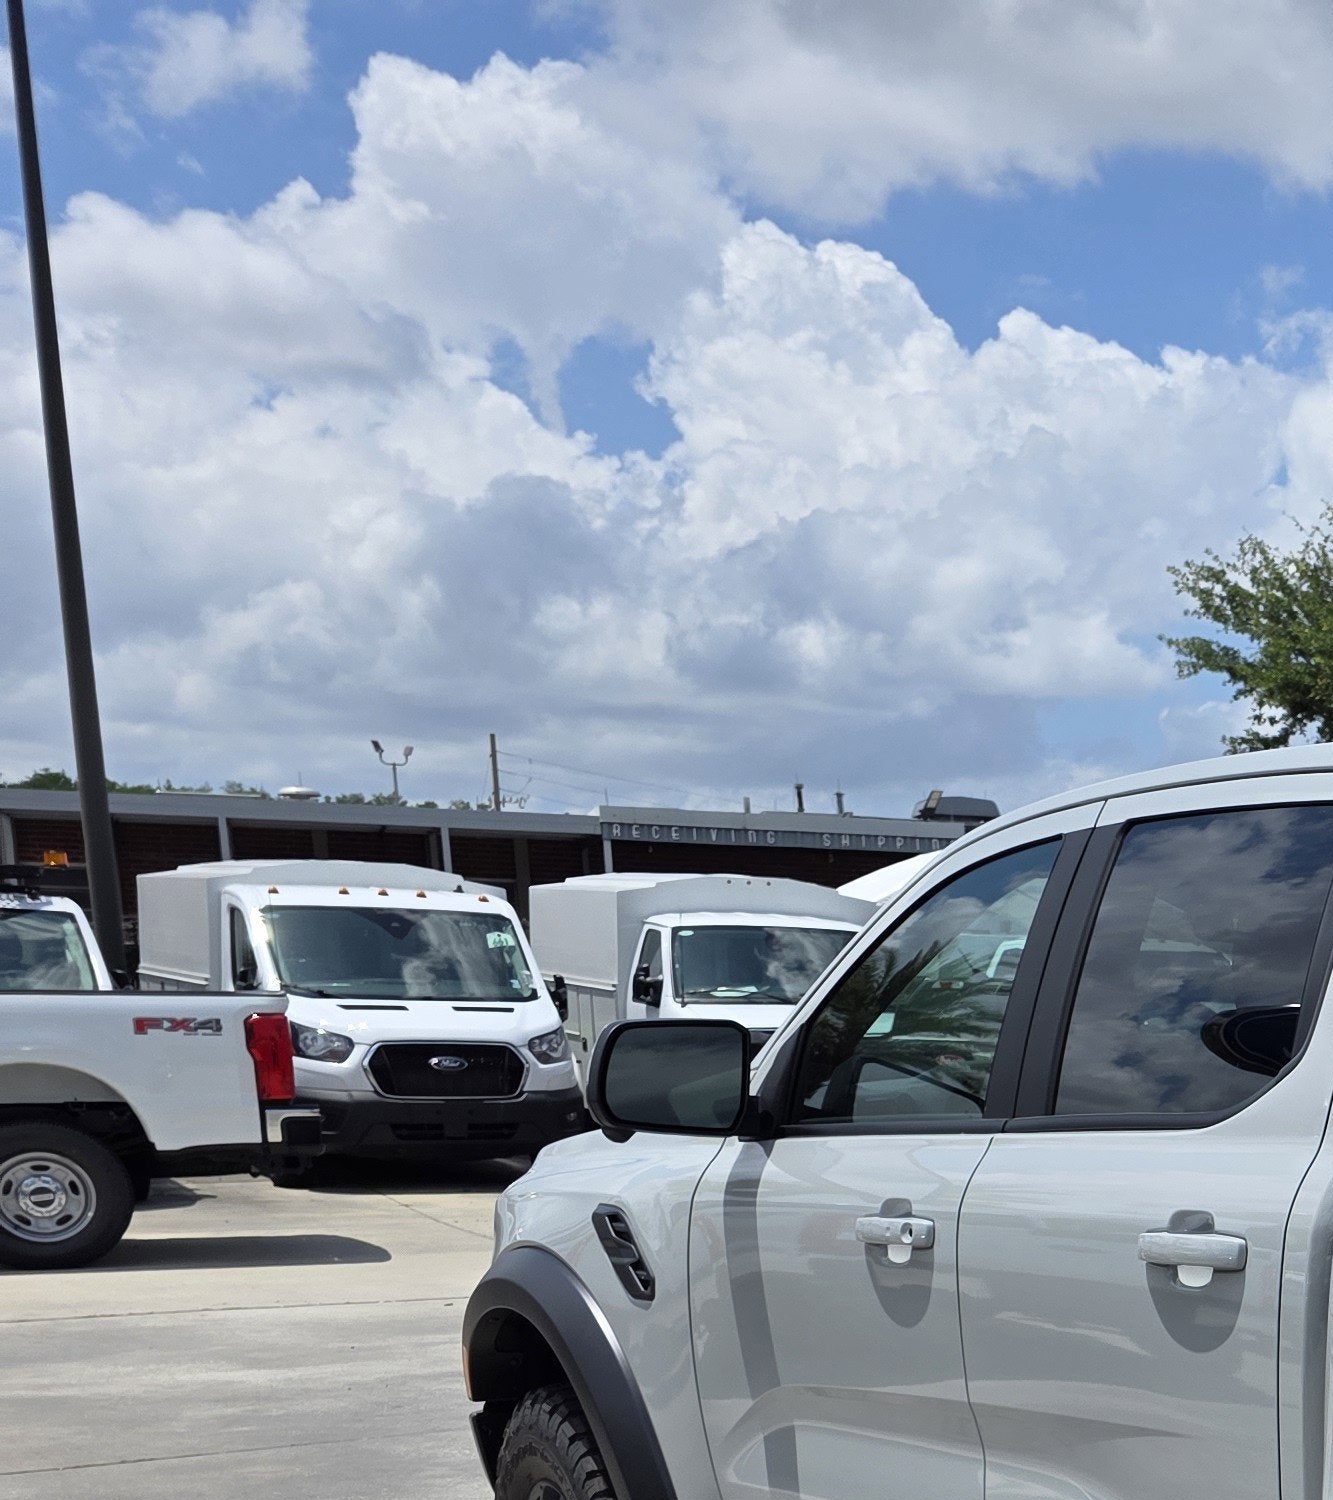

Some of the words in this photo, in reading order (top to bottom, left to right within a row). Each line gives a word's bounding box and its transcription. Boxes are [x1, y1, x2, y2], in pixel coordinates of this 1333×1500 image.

[612, 823, 776, 844] RECEIVING
[822, 832, 956, 850] SHIPPIN
[133, 1016, 223, 1036] FX4
